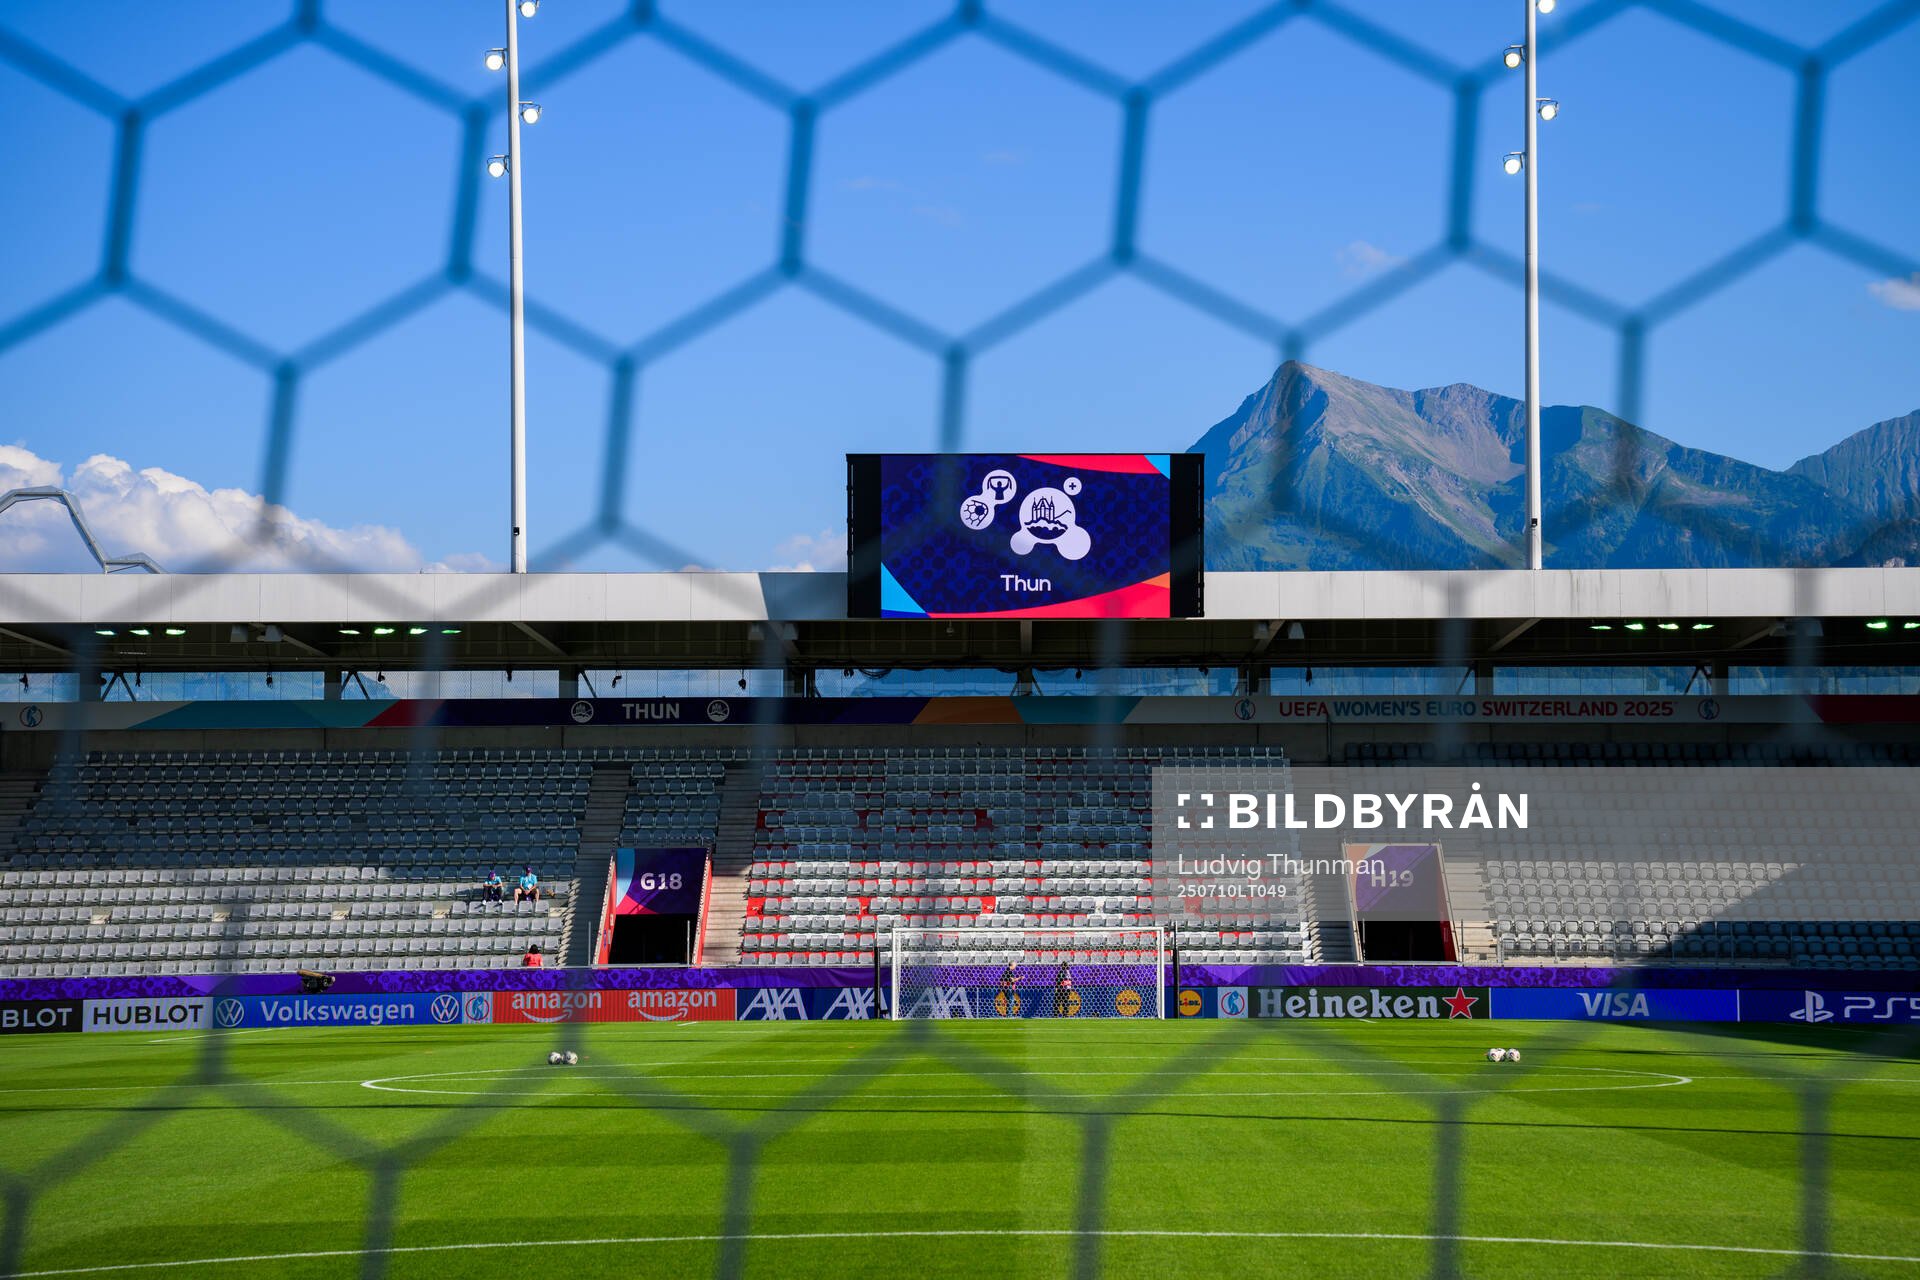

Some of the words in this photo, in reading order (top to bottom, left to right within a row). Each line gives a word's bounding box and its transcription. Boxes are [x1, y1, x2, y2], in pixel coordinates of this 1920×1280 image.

[1000, 574, 1051, 592] Thun
[622, 703, 680, 720] THUN
[1279, 701, 1329, 717] UEFA
[1334, 700, 1421, 717] WOMEN'S
[1426, 701, 1476, 717] EURO
[1482, 701, 1618, 717] SWITZERLAND
[1624, 701, 1674, 717] 2025
[640, 872, 683, 890] G18
[1371, 870, 1414, 887] H19
[512, 990, 602, 1009] amazon
[628, 989, 717, 1008] amazon
[739, 988, 808, 1020] AXA
[904, 987, 973, 1019] AXA
[1258, 988, 1440, 1018] Heineken
[1576, 992, 1650, 1017] VISA
[2, 1007, 72, 1028] BLOT
[93, 1004, 203, 1025] HUBLOT
[260, 1000, 415, 1025] Volkswagen
